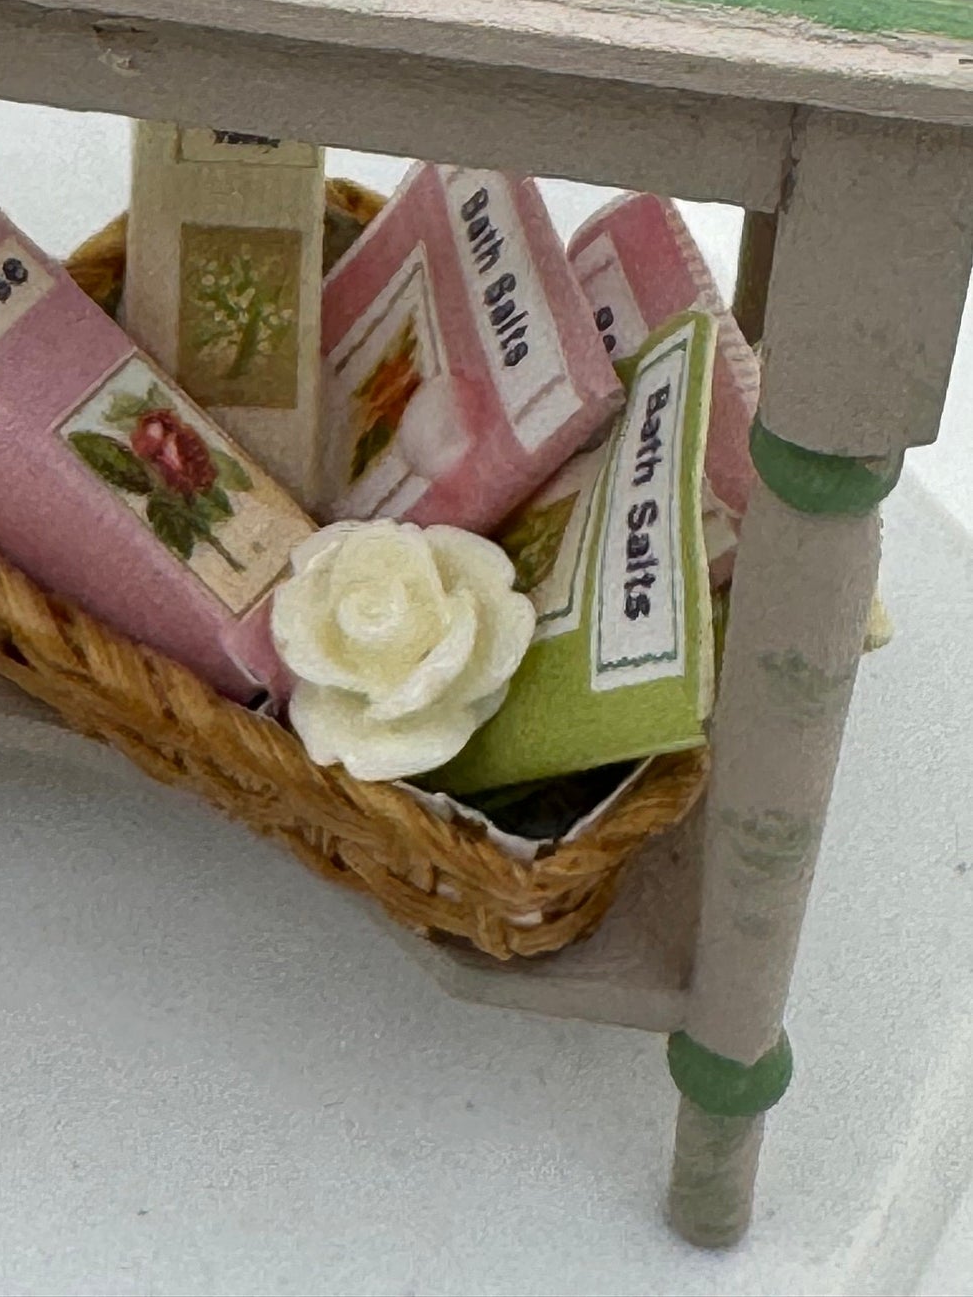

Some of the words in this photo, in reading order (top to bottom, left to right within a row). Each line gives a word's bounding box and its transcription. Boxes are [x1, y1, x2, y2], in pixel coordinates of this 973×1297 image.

[460, 186, 505, 275] Bath
[483, 272, 529, 368] Salts
[631, 382, 672, 488] Bath
[623, 499, 660, 622] Salts
